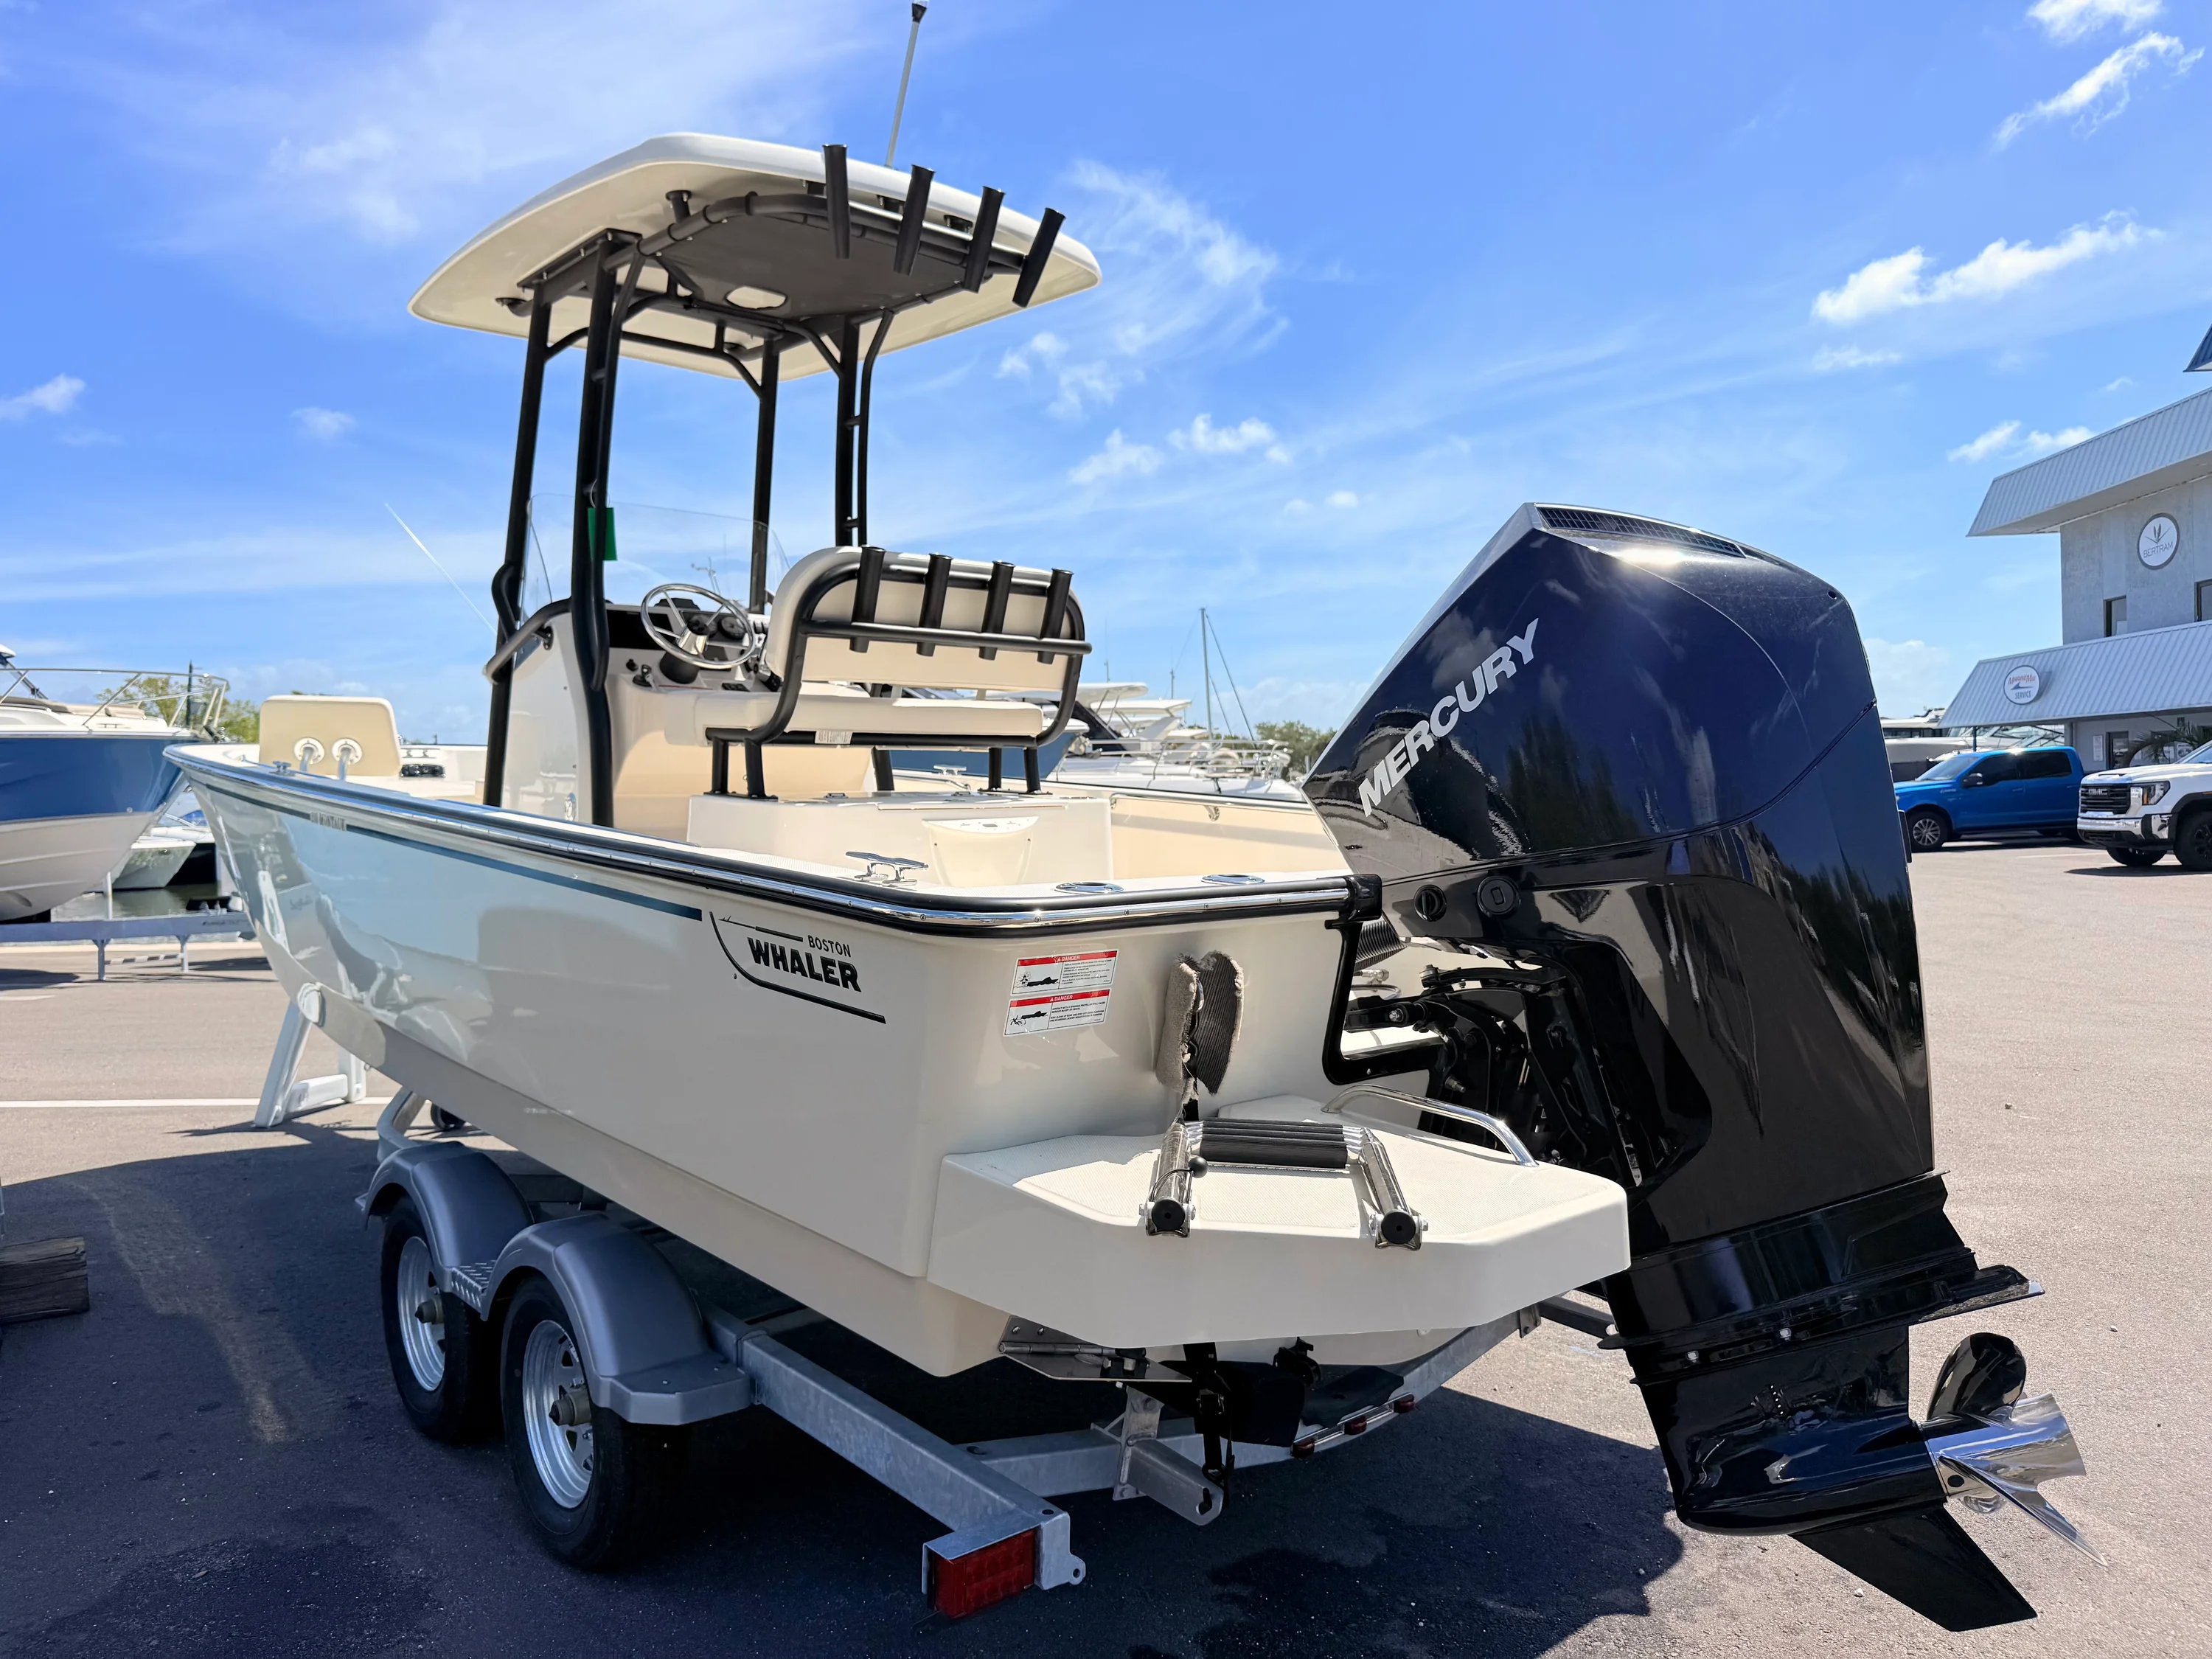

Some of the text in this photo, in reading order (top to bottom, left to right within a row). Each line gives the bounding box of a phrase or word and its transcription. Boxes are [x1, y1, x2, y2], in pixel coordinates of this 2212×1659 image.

[2143, 541, 2173, 558] BERTRAM
[2014, 690, 2031, 700] SERVICE
[1357, 618, 1539, 817] MERCURY
[807, 935, 852, 958] BOSTON
[747, 936, 862, 992] WHALER
